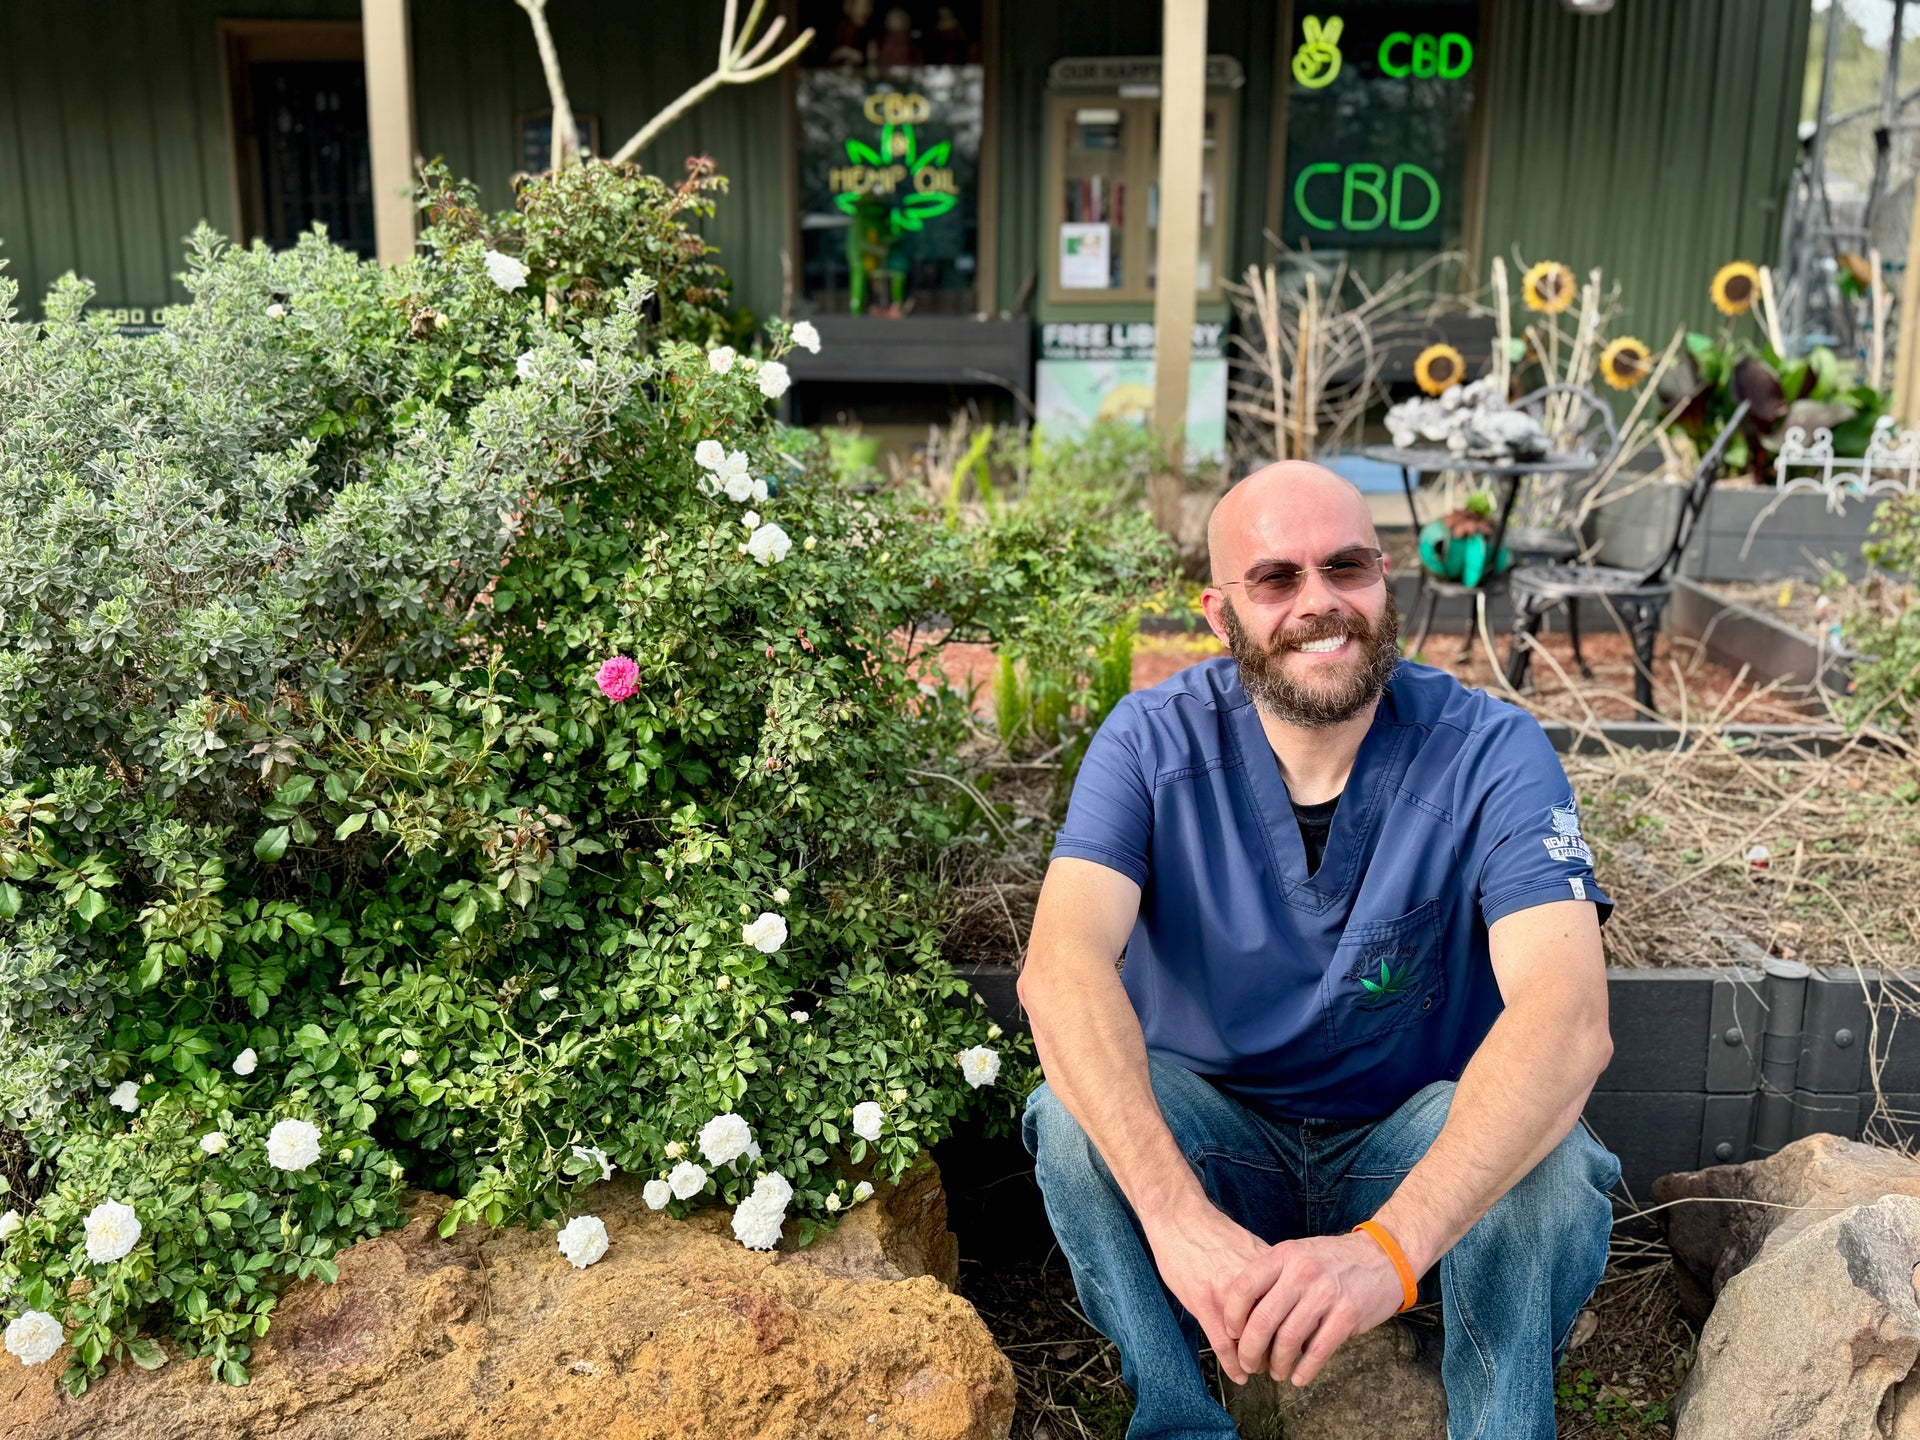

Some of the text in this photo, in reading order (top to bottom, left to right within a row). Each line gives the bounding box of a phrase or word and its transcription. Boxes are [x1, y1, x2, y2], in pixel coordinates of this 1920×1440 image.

[1378, 31, 1473, 79] CBD
[864, 93, 930, 125] CBD
[829, 165, 959, 195] HEMP OIL
[1294, 162, 1441, 231] CBD
[101, 309, 146, 325] BD
[1043, 323, 1222, 347] FREE LIBRY
[1543, 836, 1570, 850] HEMP
